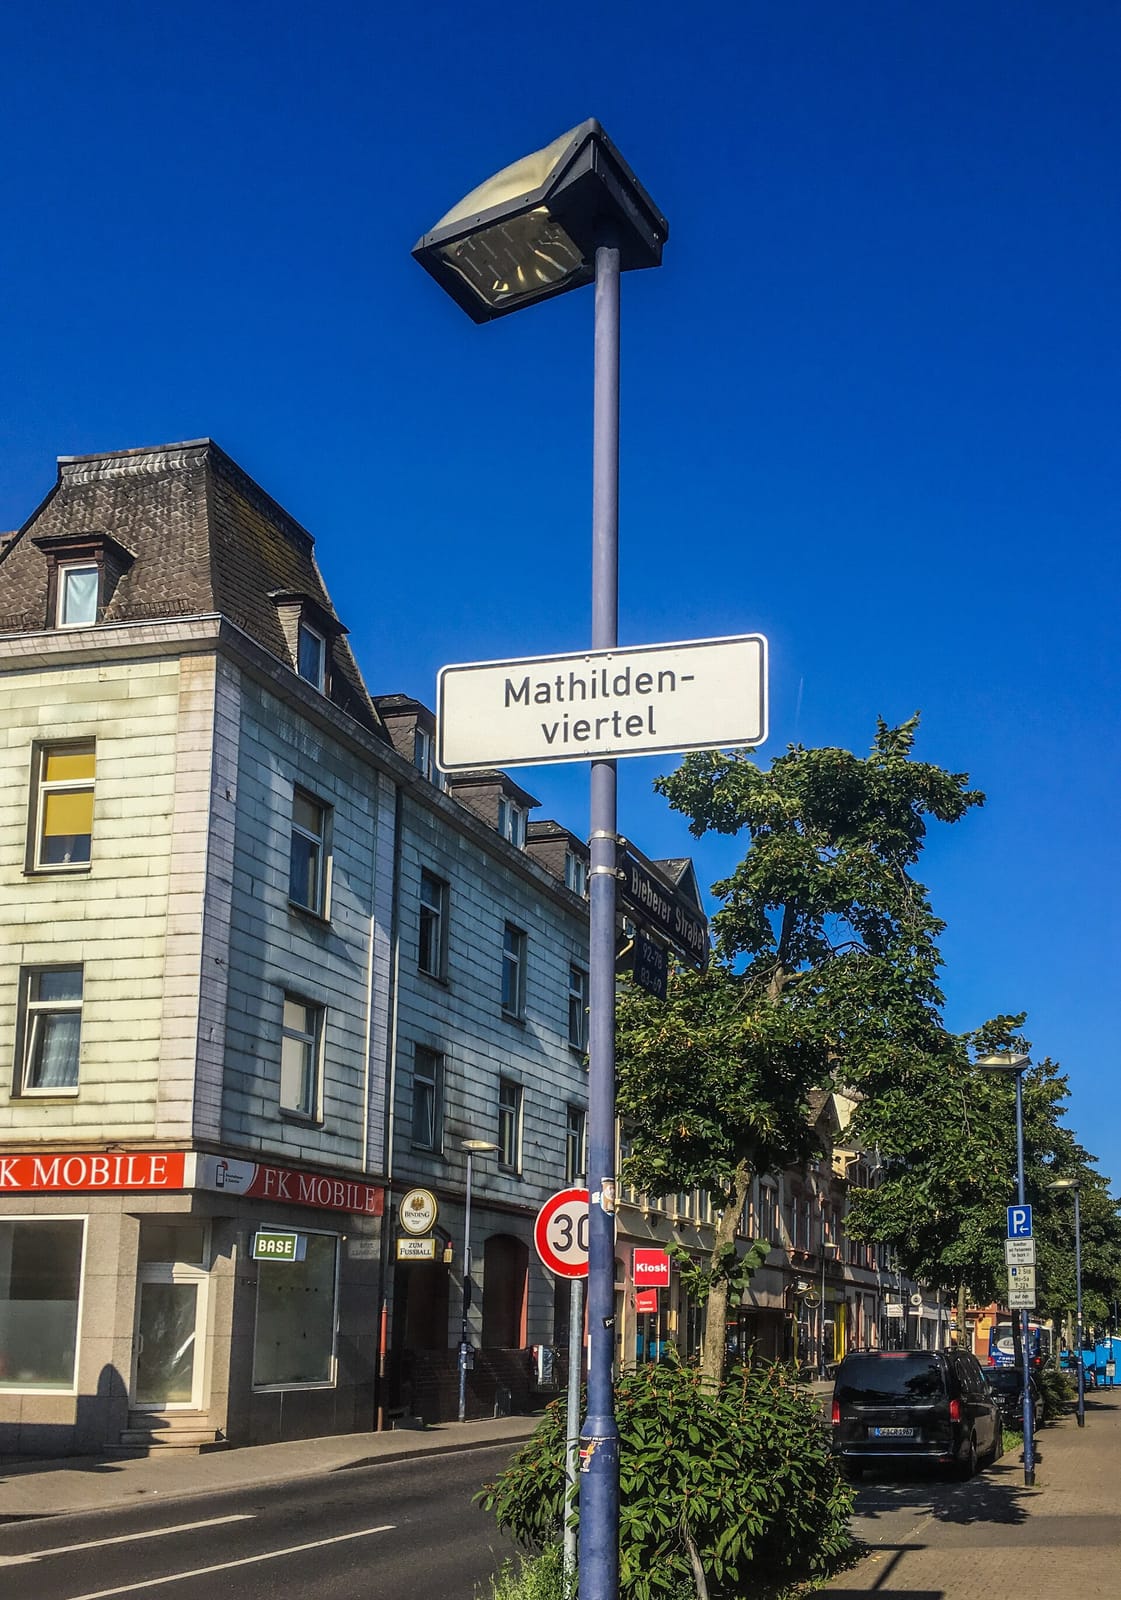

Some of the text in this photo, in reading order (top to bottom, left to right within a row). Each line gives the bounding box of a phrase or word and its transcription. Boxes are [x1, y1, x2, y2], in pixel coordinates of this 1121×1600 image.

[504, 667, 695, 707] Mathilden-
[541, 705, 657, 745] viertel
[631, 866, 702, 950] Bieberer Straße
[31, 1156, 168, 1187] MOBILE
[263, 1168, 375, 1213] FK MOBILE
[404, 1210, 430, 1218] BINDING
[1013, 1209, 1026, 1234] P
[258, 1239, 292, 1254] BASE
[636, 1263, 667, 1272] Kiosk
